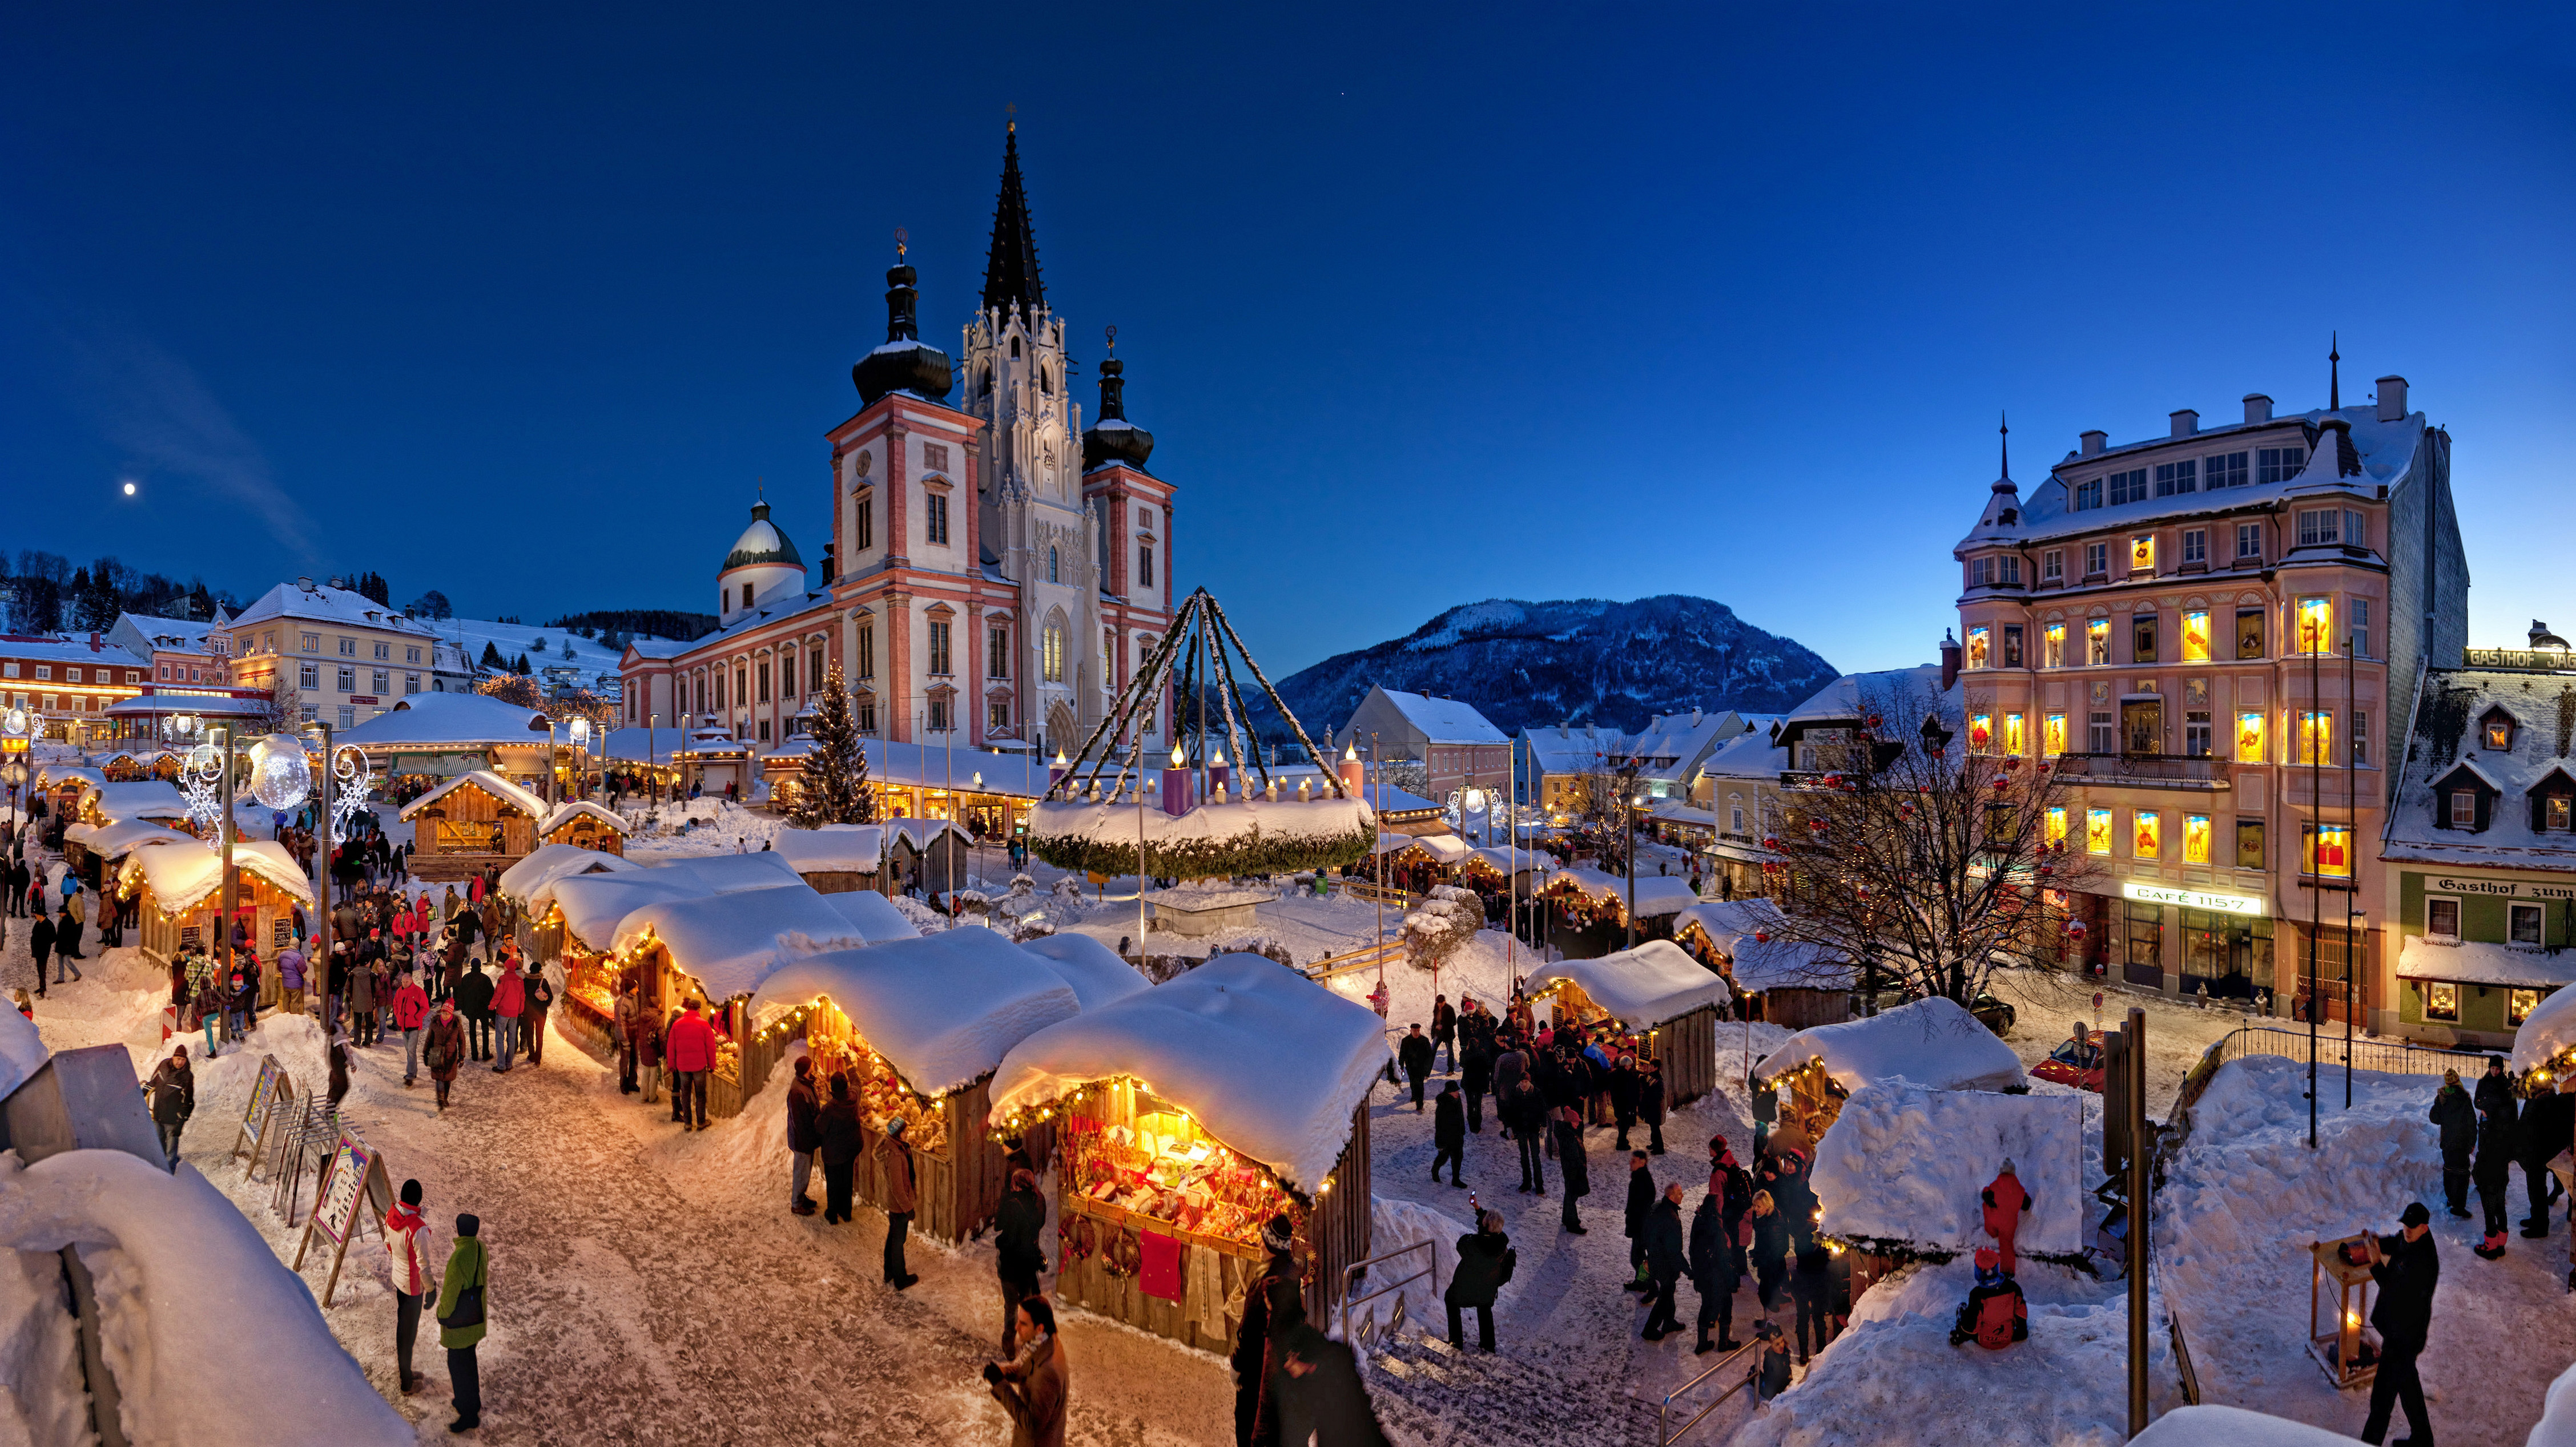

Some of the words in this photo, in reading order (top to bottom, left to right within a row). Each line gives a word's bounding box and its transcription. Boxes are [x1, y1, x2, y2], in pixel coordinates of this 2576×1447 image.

[2470, 650, 2534, 667] GASTHOF
[2438, 878, 2518, 895] Gasthof
[2531, 888, 2574, 898] zum
[2138, 889, 2189, 904] CAFÉ
[2199, 896, 2245, 909] 1157
[248, 1074, 266, 1124] AMIGOS
